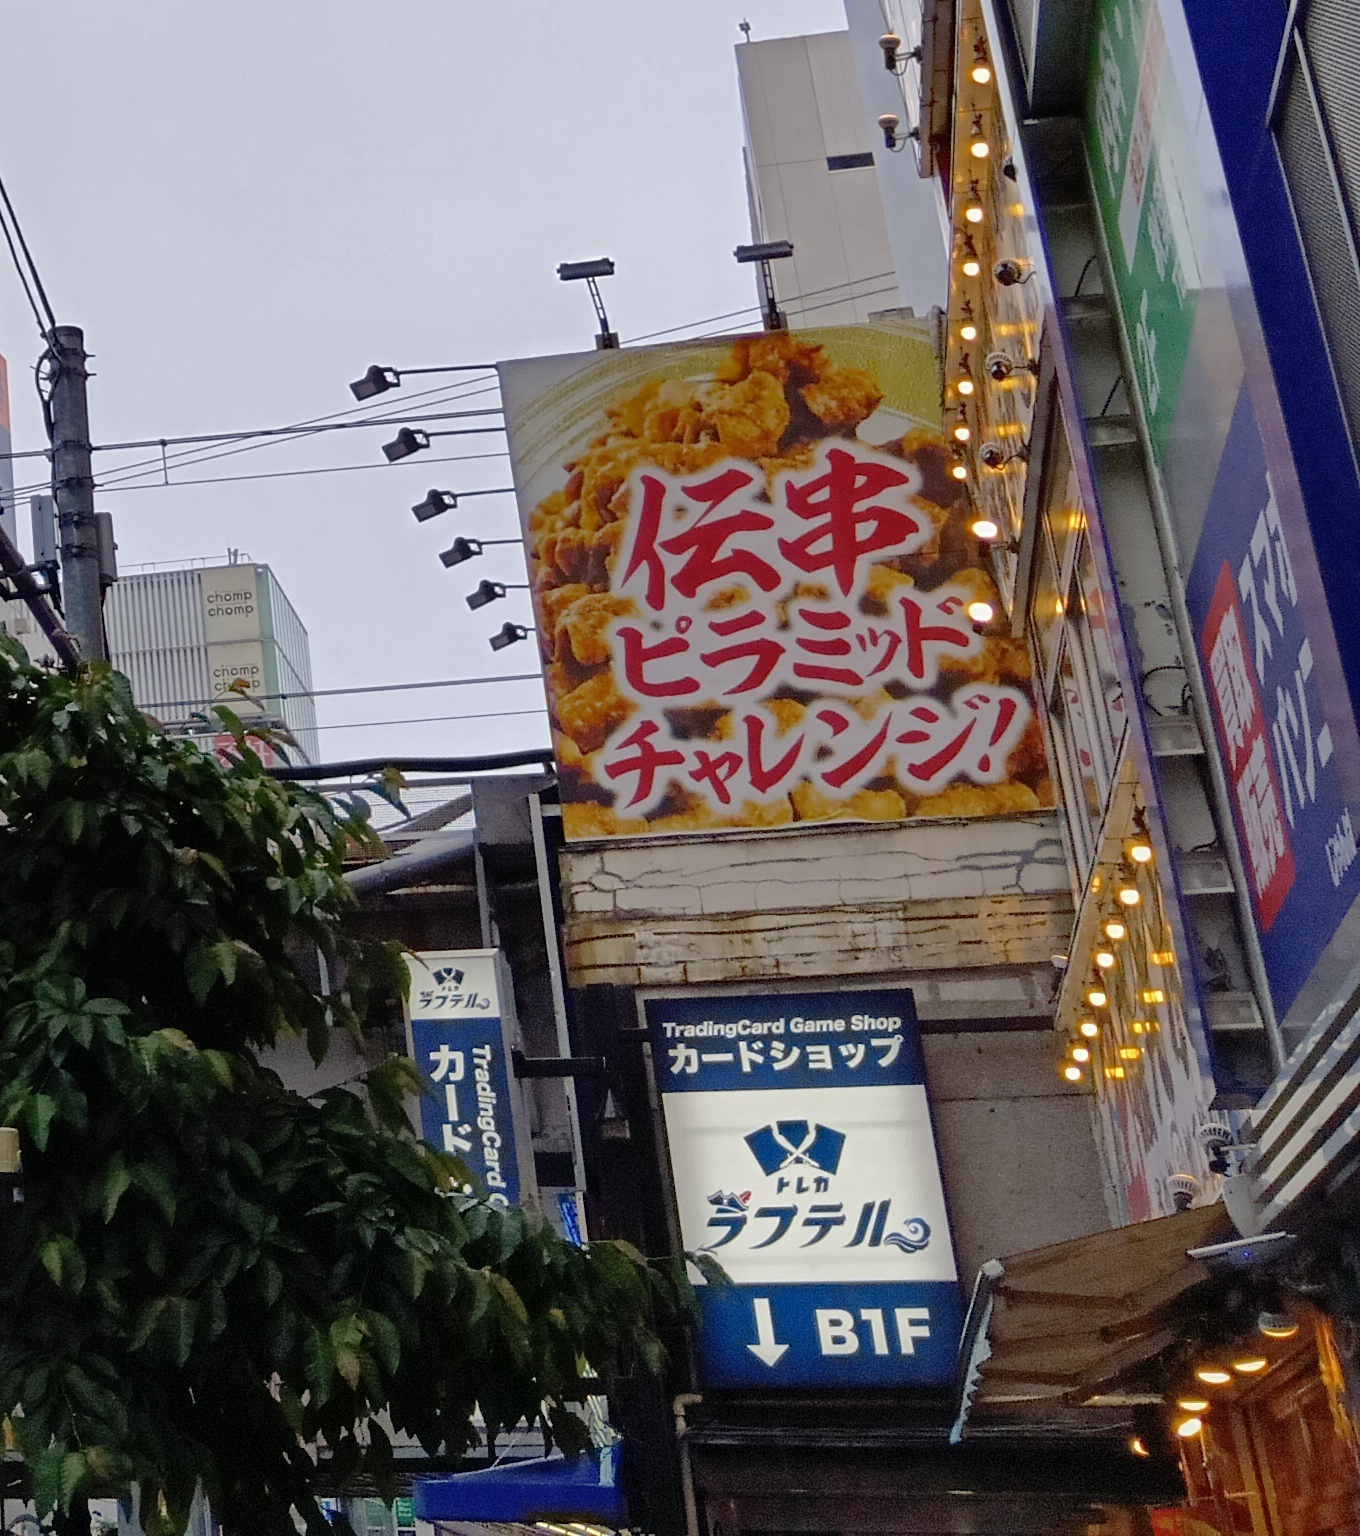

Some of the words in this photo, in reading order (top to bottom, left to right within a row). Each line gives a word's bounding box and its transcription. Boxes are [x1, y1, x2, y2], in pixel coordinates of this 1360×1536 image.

[621, 448, 920, 611] 伝串
[616, 596, 970, 698] ピラミッド
[662, 1017, 785, 1038] TradingCard
[790, 1016, 846, 1034] Game
[850, 1014, 902, 1033] Shop
[667, 1034, 905, 1075] カードショップ
[472, 1044, 506, 1188] TradingCard
[776, 1175, 830, 1195] トレカ
[698, 1198, 892, 1250] ラフテル
[815, 1307, 931, 1356] B1F
